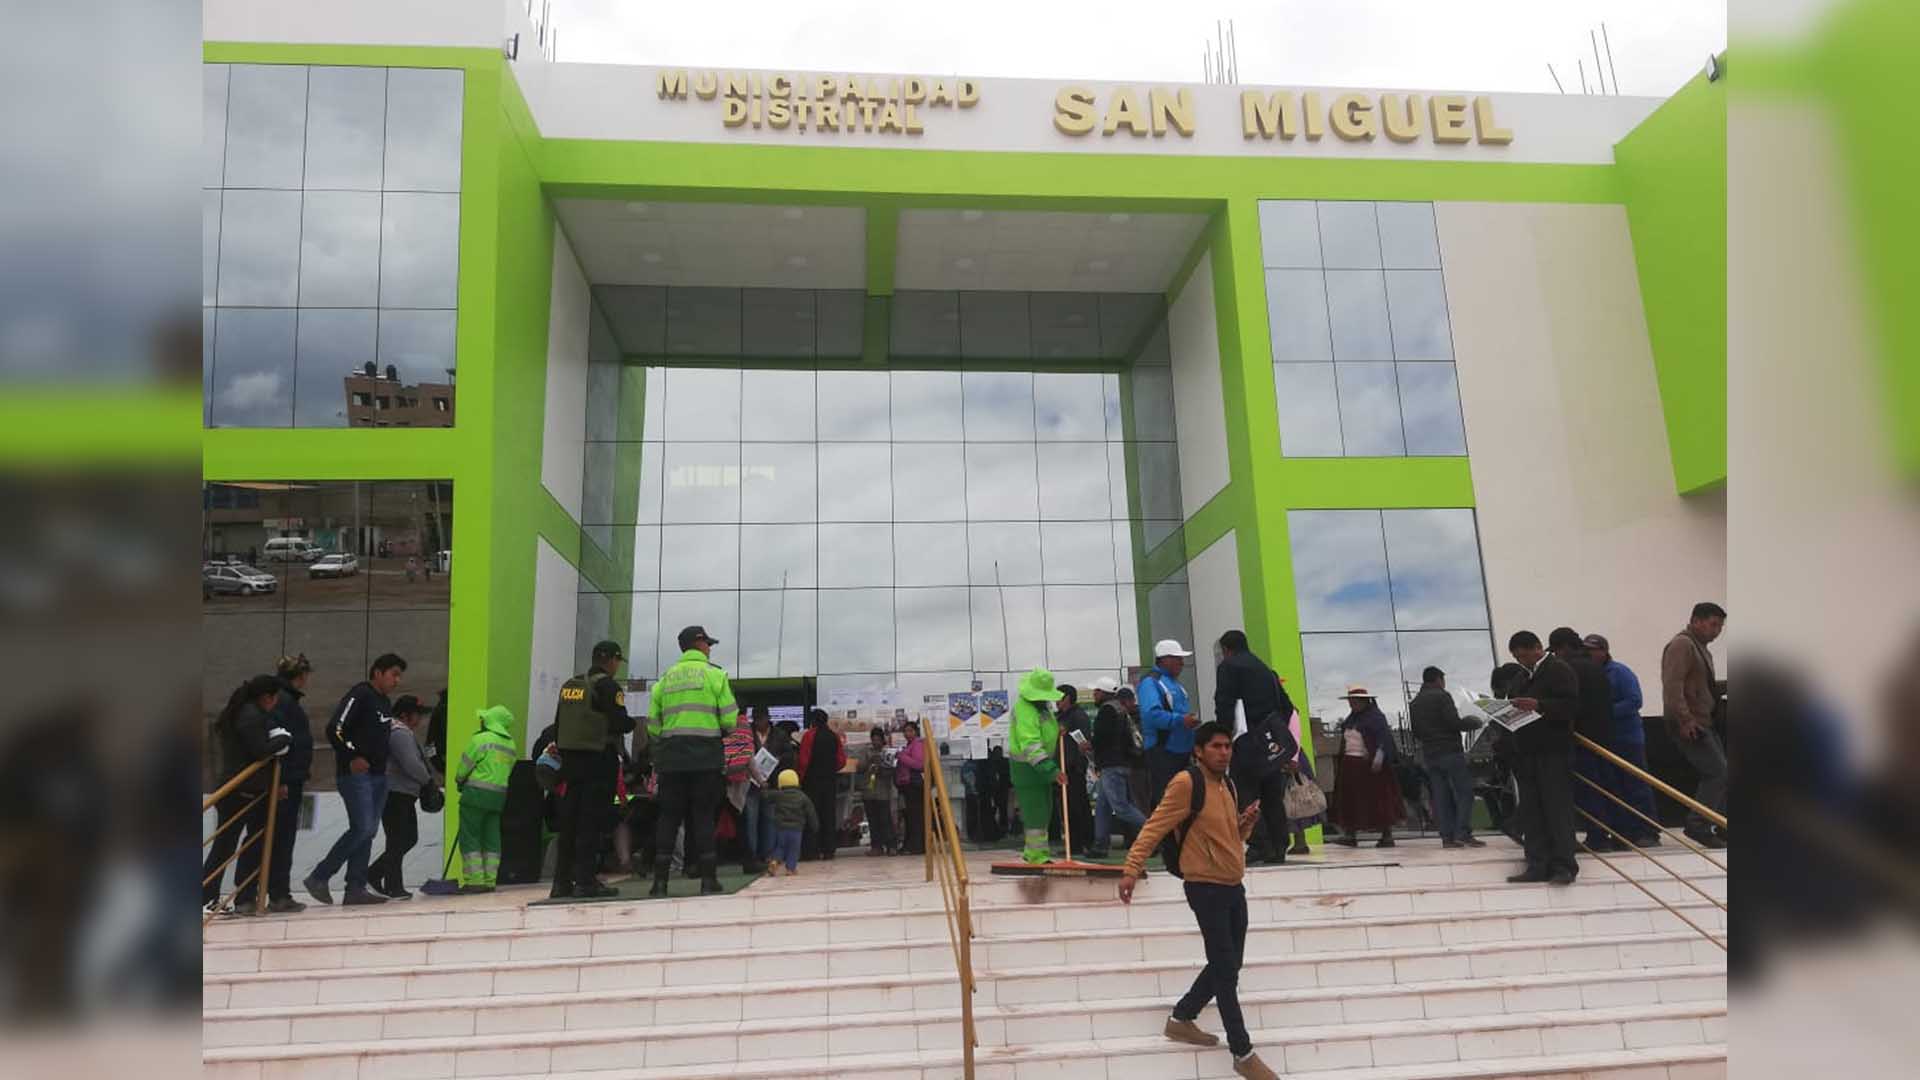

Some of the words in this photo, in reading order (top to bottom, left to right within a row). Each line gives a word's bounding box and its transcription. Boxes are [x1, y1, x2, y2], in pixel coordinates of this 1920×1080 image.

[656, 70, 982, 108] MUNICIPALIDAD
[723, 98, 924, 134] DISTRITAL
[1053, 85, 1196, 138] SAN
[1240, 90, 1515, 146] MIGUEL
[561, 688, 585, 701] POLICIA
